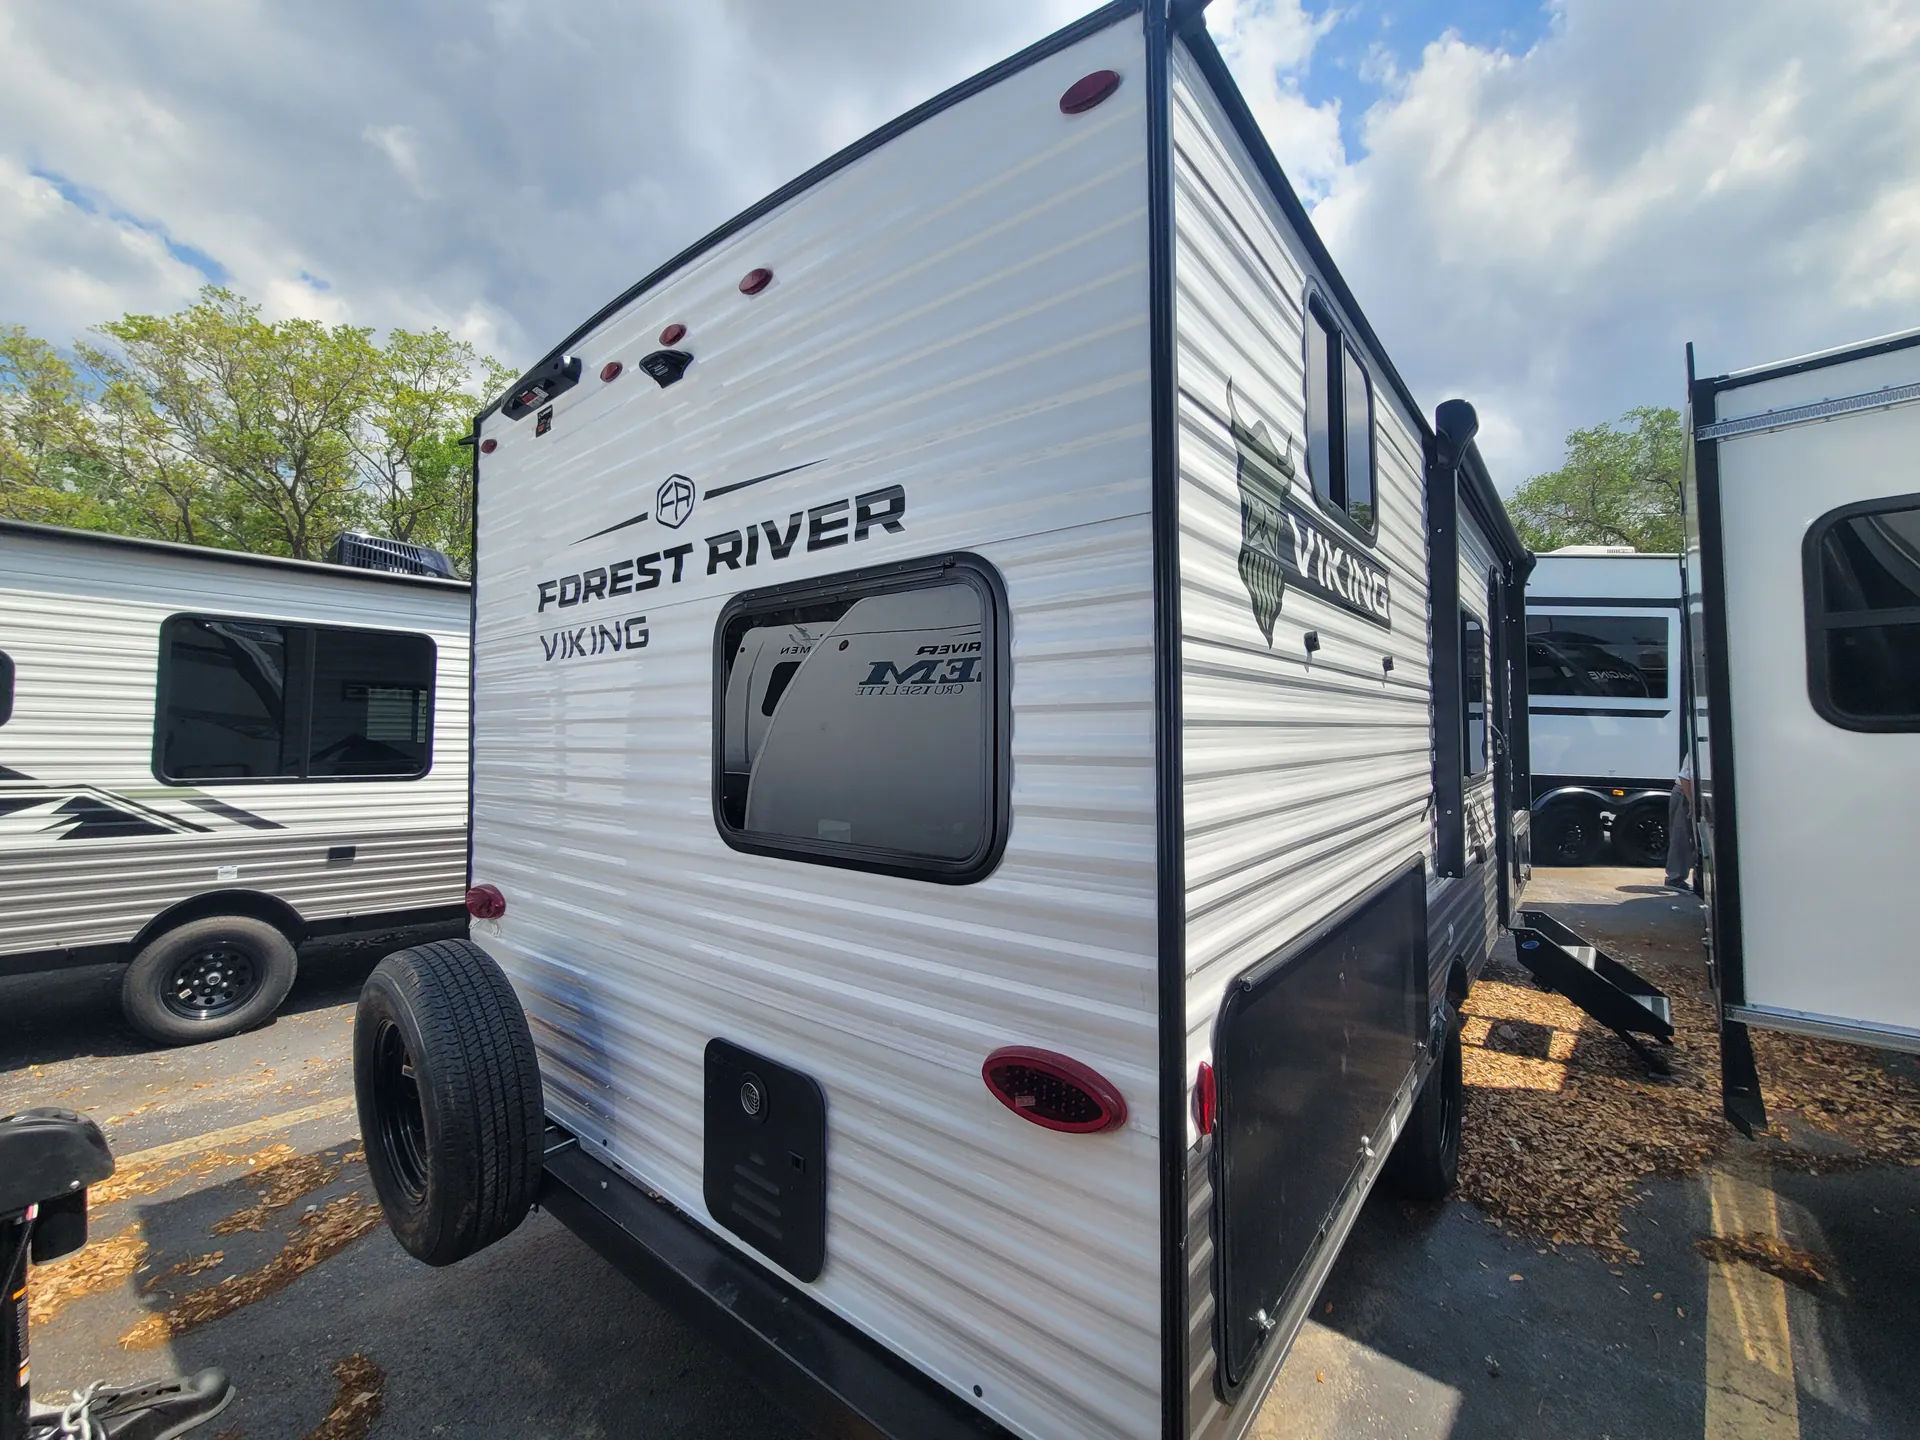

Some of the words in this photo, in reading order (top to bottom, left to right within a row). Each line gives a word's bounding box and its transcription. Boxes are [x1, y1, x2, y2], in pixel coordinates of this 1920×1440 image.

[537, 543, 694, 613] FOREST
[704, 484, 906, 576] RIVER
[1287, 512, 1390, 621] VIKING
[539, 616, 650, 661] VIKING
